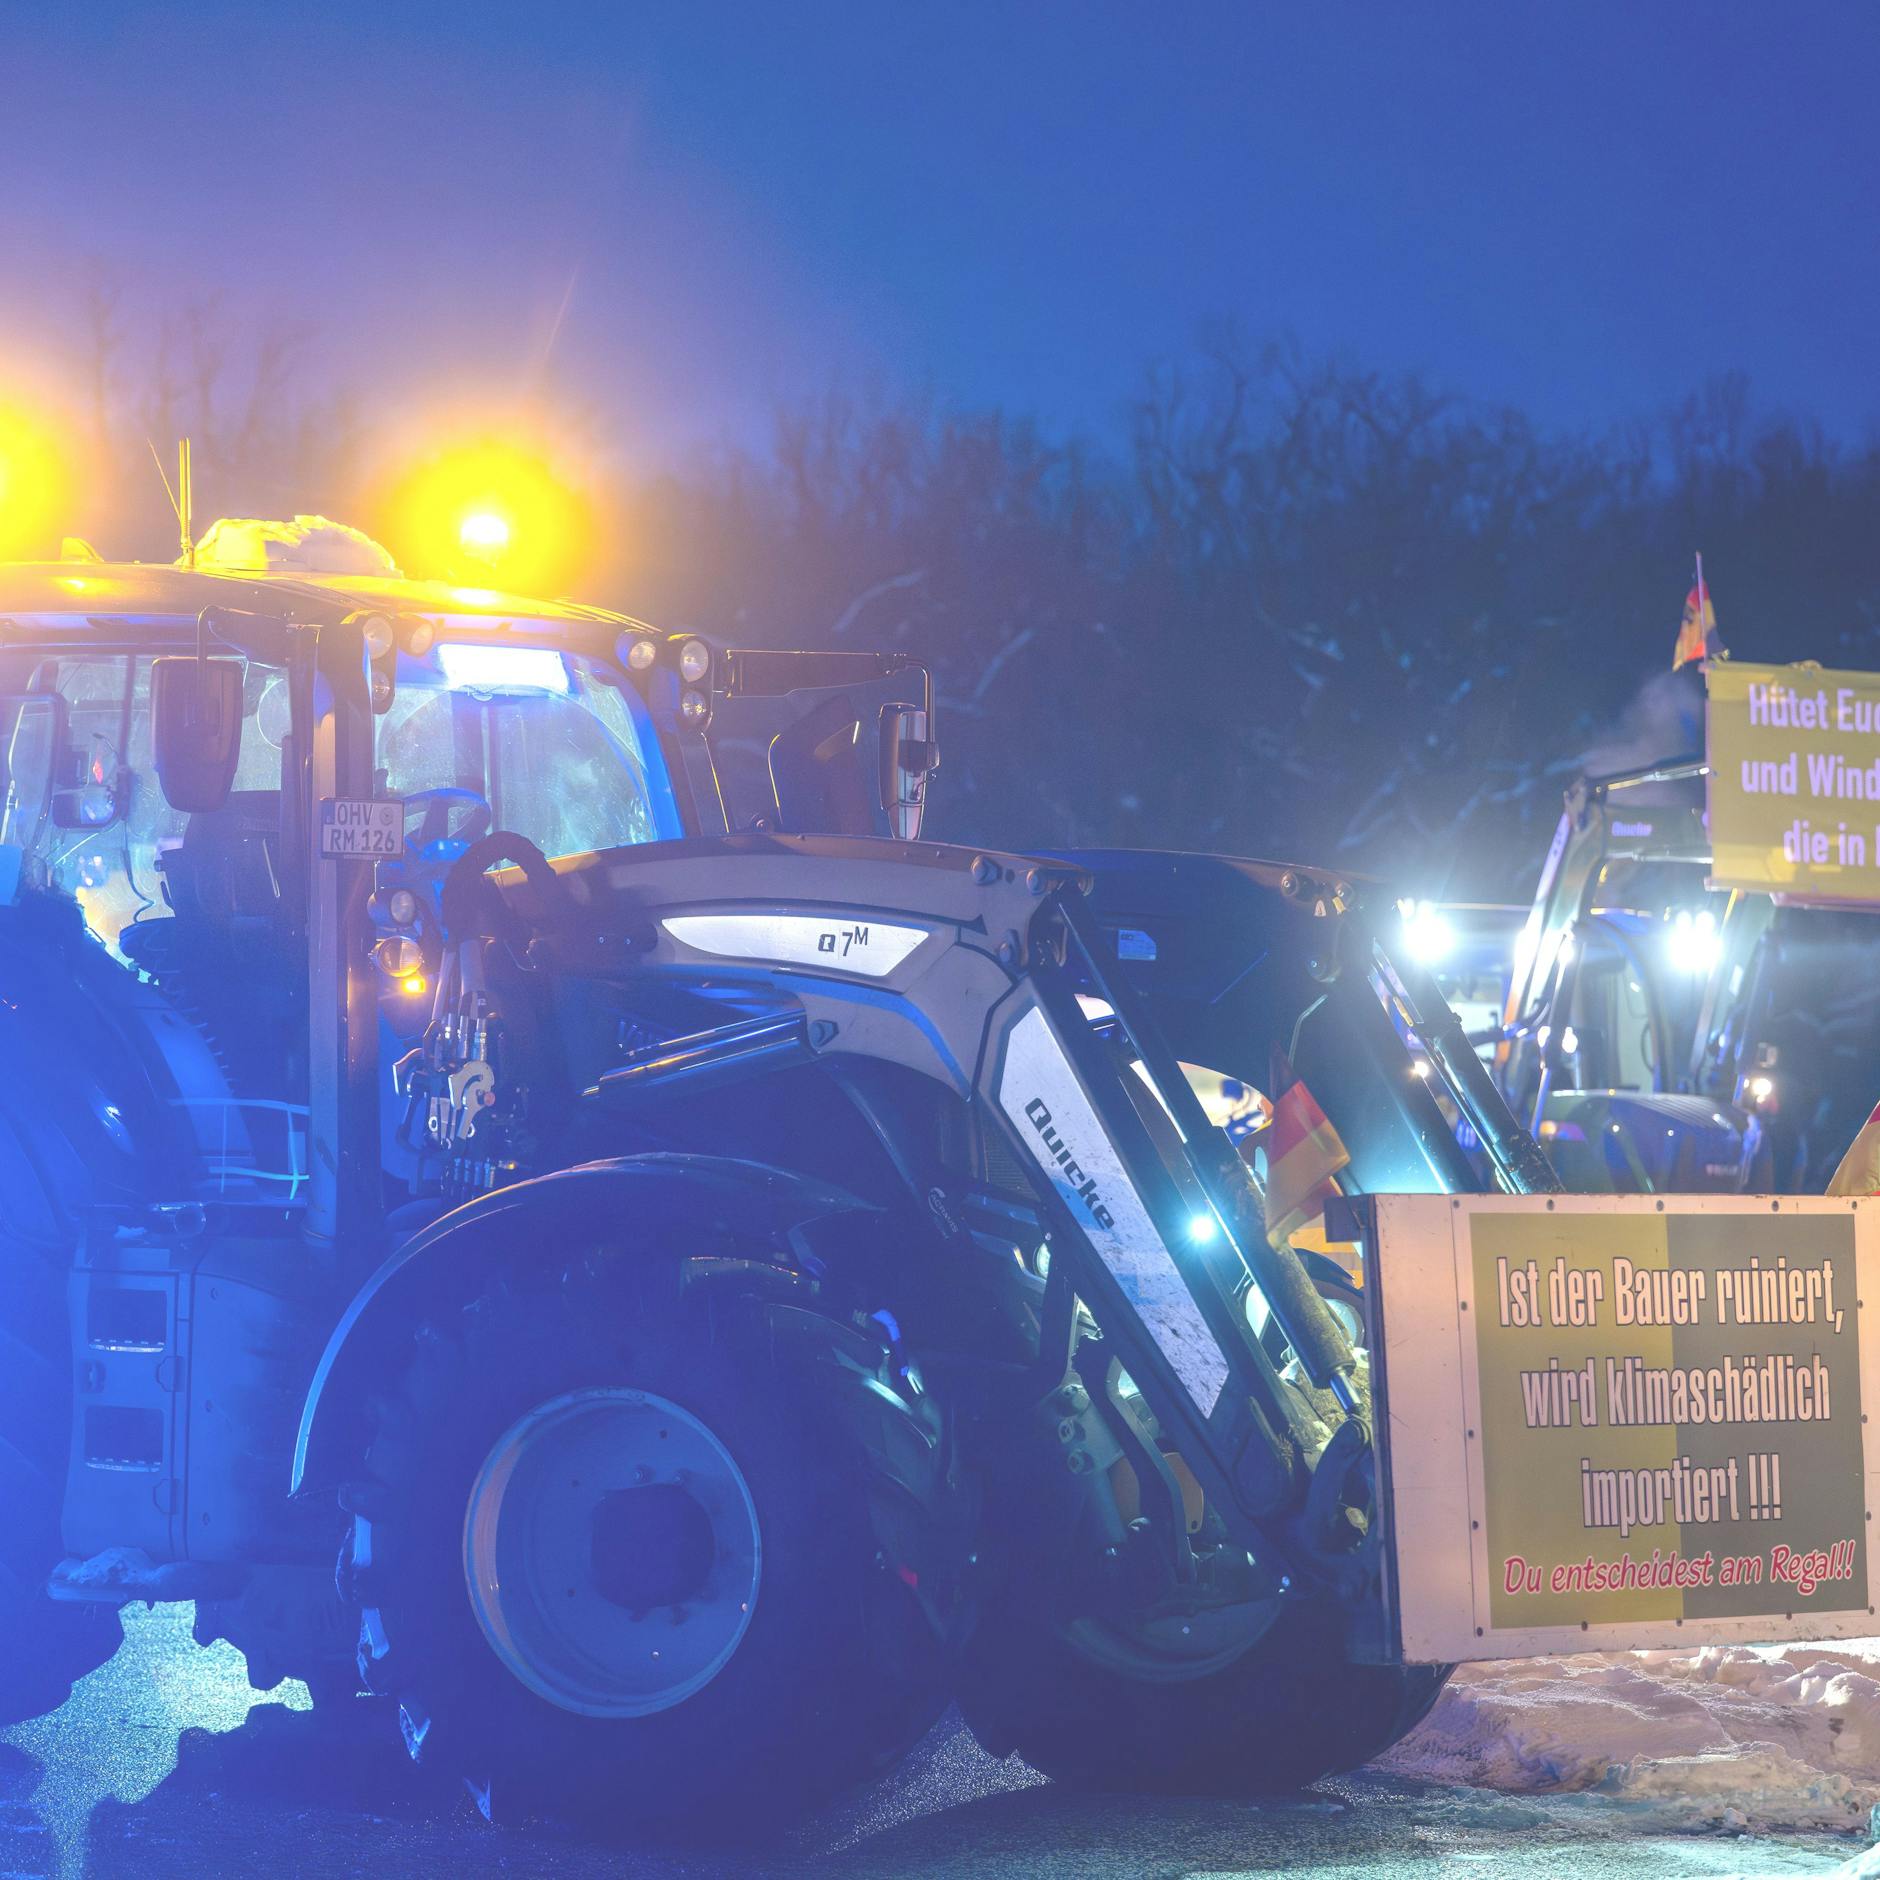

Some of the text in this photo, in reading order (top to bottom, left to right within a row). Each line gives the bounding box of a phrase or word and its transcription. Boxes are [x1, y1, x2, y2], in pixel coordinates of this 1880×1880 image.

[1749, 683, 1828, 730] Hütet
[1741, 752, 1880, 801] und Wind
[330, 829, 395, 852] RM 126
[337, 804, 373, 825] OHV
[1783, 819, 1829, 863] die
[1838, 822, 1865, 866] in
[1025, 1097, 1115, 1230] Quicke
[1496, 1256, 1845, 1334] Ist der Bauer ruiniert,
[1520, 1353, 1831, 1428] wird klimaschädlich
[1580, 1453, 1782, 1538] importiert !!!
[1504, 1540, 1856, 1597] Du entscheidest am Regal!!
